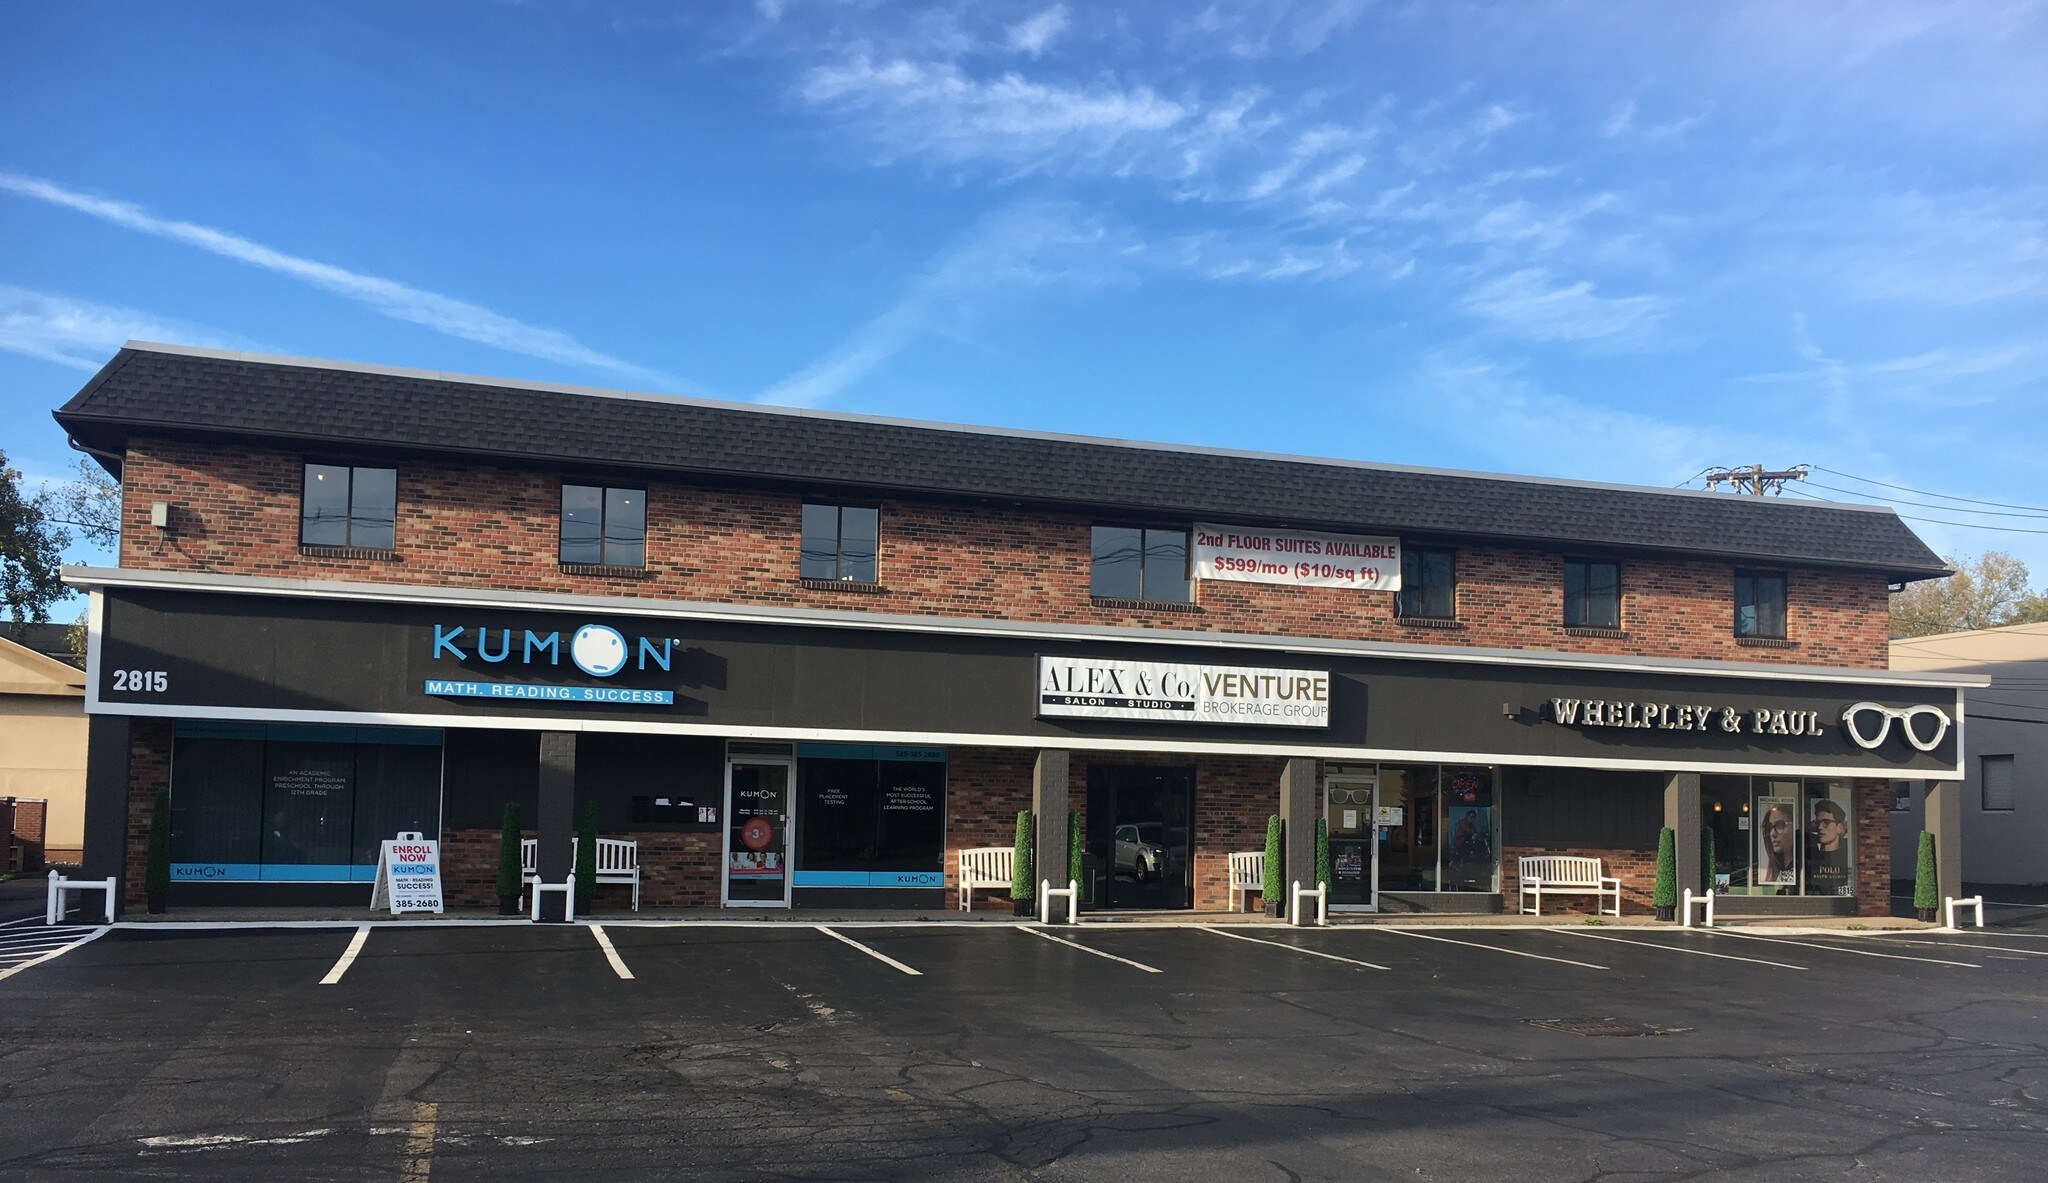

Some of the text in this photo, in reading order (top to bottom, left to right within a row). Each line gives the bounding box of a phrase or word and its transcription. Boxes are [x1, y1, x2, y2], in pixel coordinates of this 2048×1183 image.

[1197, 531, 1396, 560] 2nd FLOOR SUITES AVAILABLE
[1214, 555, 1380, 584] $599/mo ($10/sq ft)
[433, 624, 672, 678] KUMON
[113, 669, 168, 692] 2815
[1044, 665, 1196, 699] ALEX & Co.
[1202, 672, 1328, 702] VENTURE
[428, 682, 670, 703] MATH. READING. SUCCESS.
[1064, 695, 1172, 710] SALON STUDIO
[1203, 700, 1328, 718] BROKERAGE GROUP
[1551, 697, 1824, 736] WHELPLEY & PAUL
[740, 789, 777, 799] KUMON
[393, 845, 432, 854] ENROLL
[400, 854, 427, 862] NOW
[176, 866, 226, 878] KUMON
[393, 865, 433, 875] KUMON
[1819, 865, 1841, 874] POLO
[898, 874, 936, 884] KUMON
[1838, 886, 1854, 897] 2815
[395, 900, 439, 908] 385-2680
